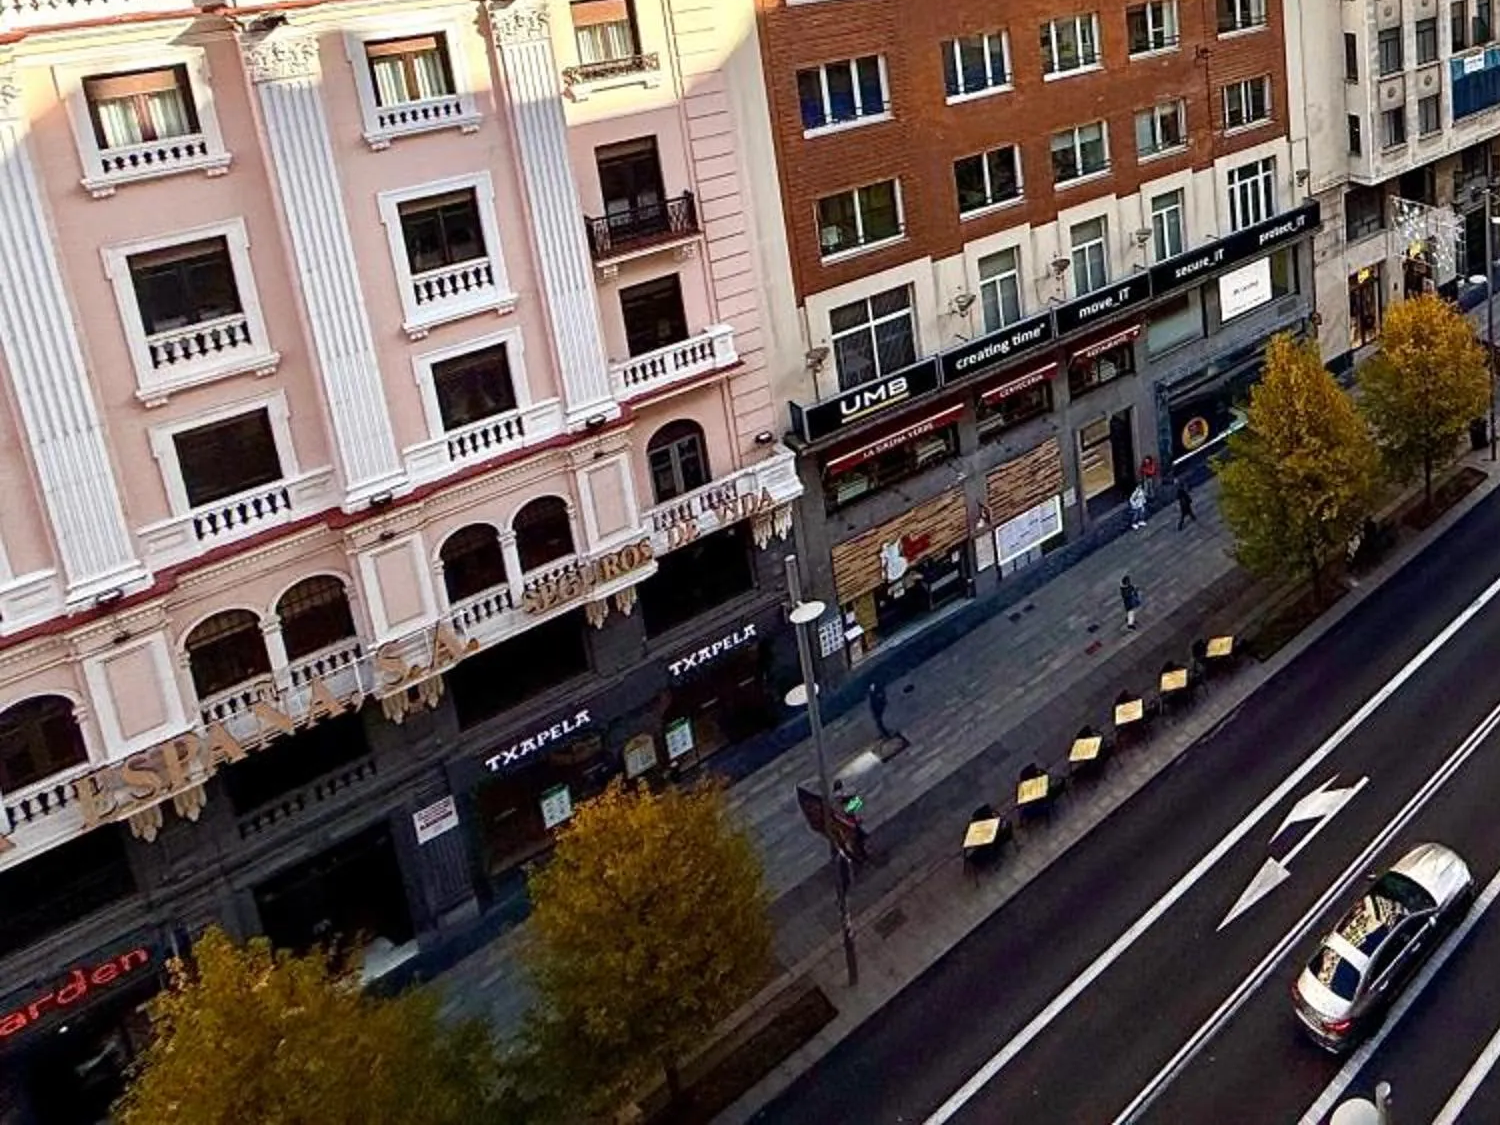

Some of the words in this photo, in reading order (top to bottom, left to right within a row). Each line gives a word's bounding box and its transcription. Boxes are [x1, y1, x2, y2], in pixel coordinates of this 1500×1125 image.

[1175, 248, 1225, 278] secure_IT
[1079, 286, 1131, 319] move_IT
[955, 339, 1011, 370] creating
[840, 376, 908, 416] UMB
[521, 538, 652, 615] SEGUROS
[667, 623, 757, 676] TXAPELA
[484, 708, 593, 773] TXAPELA
